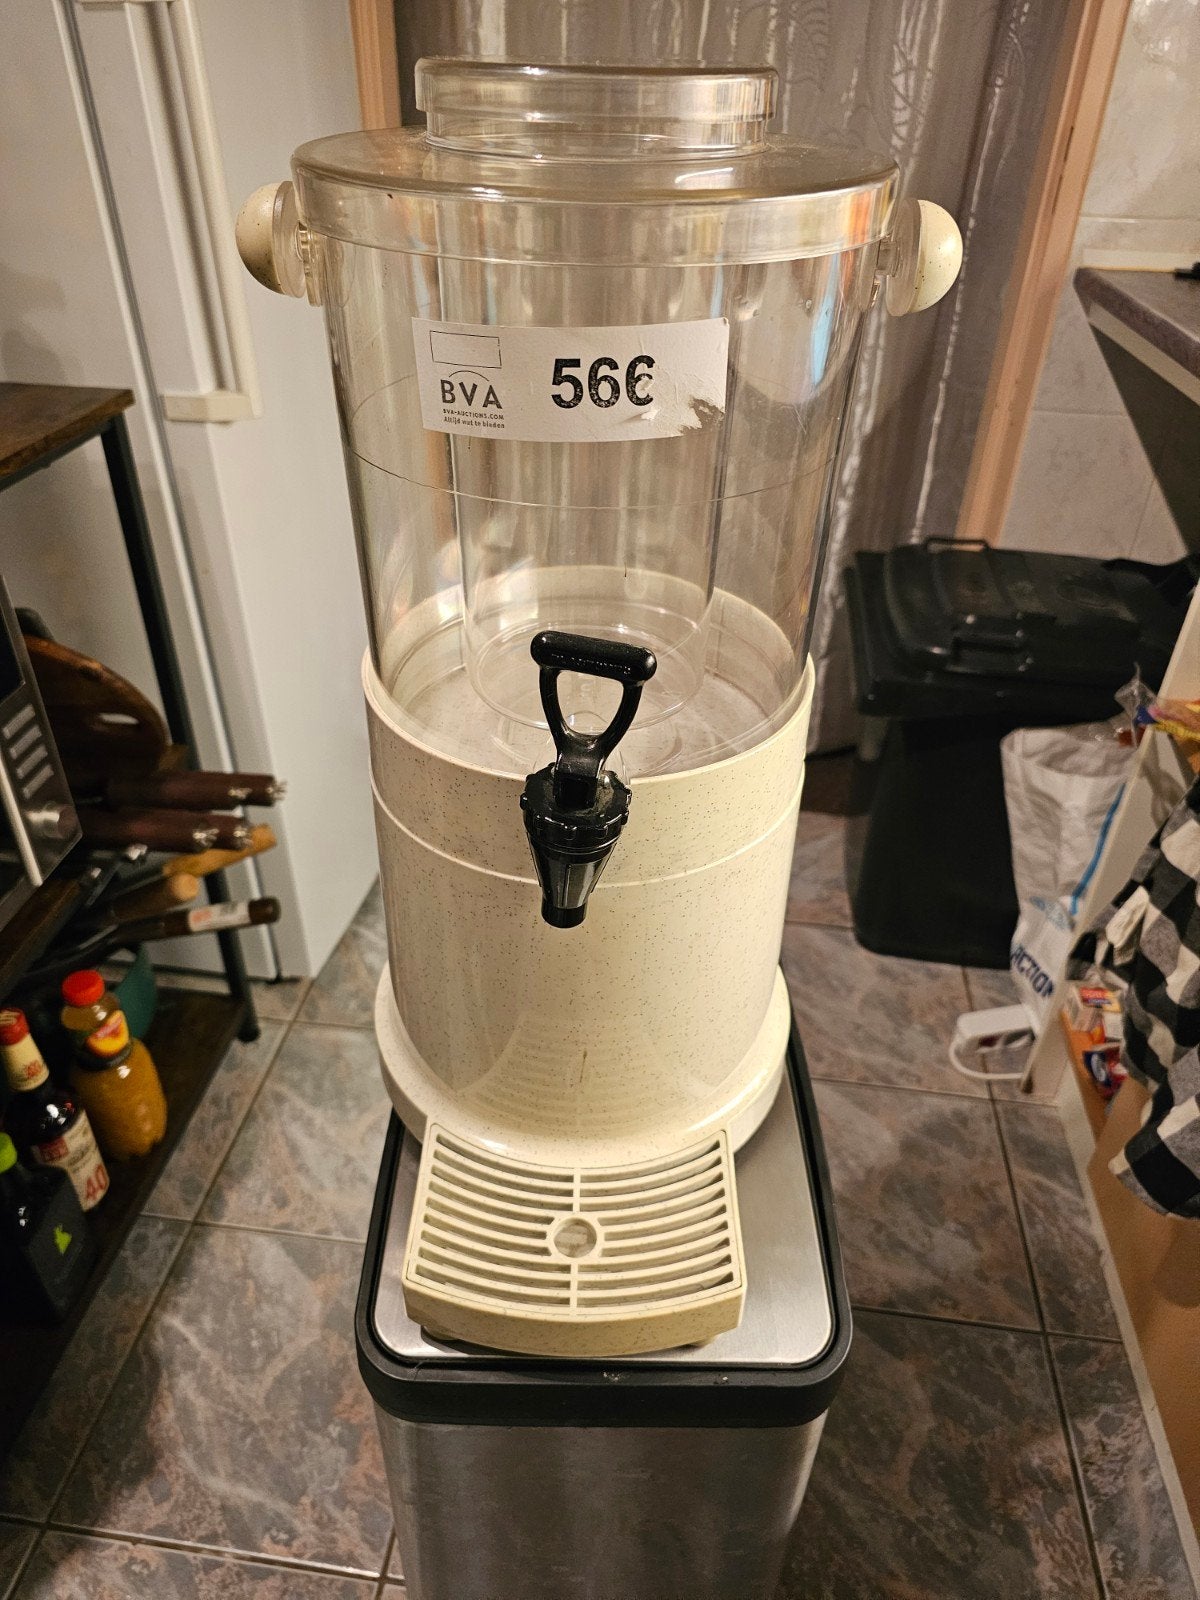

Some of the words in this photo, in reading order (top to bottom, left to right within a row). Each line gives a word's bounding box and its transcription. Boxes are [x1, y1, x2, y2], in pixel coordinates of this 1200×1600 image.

[440, 379, 503, 409] BVA
[443, 408, 504, 420] BVA-AUCTIONS.COM
[444, 416, 461, 425] Altijd
[482, 420, 505, 428] bieden
